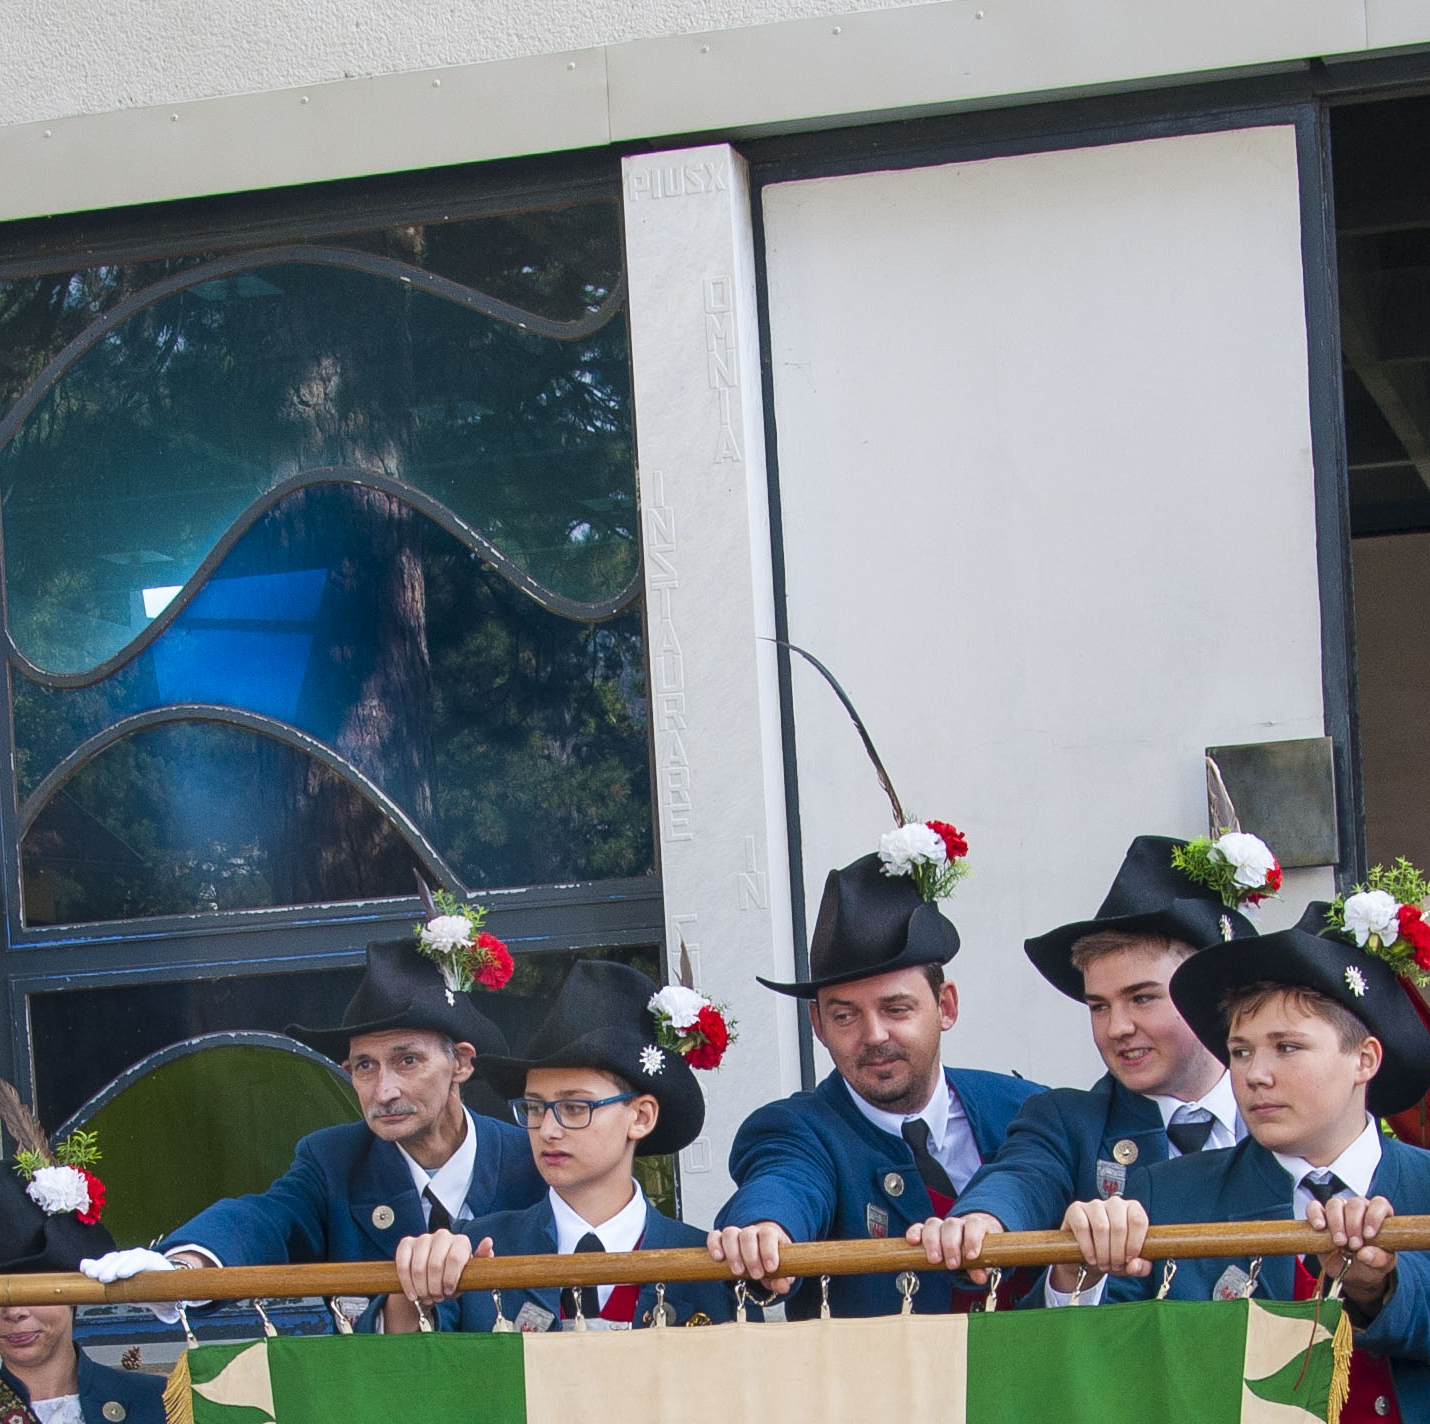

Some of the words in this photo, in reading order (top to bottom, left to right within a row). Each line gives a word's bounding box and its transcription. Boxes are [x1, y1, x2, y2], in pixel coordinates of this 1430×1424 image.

[702, 273, 743, 464] OMNIA
[646, 468, 695, 843] INSTAURARE
[737, 833, 771, 912] IN
